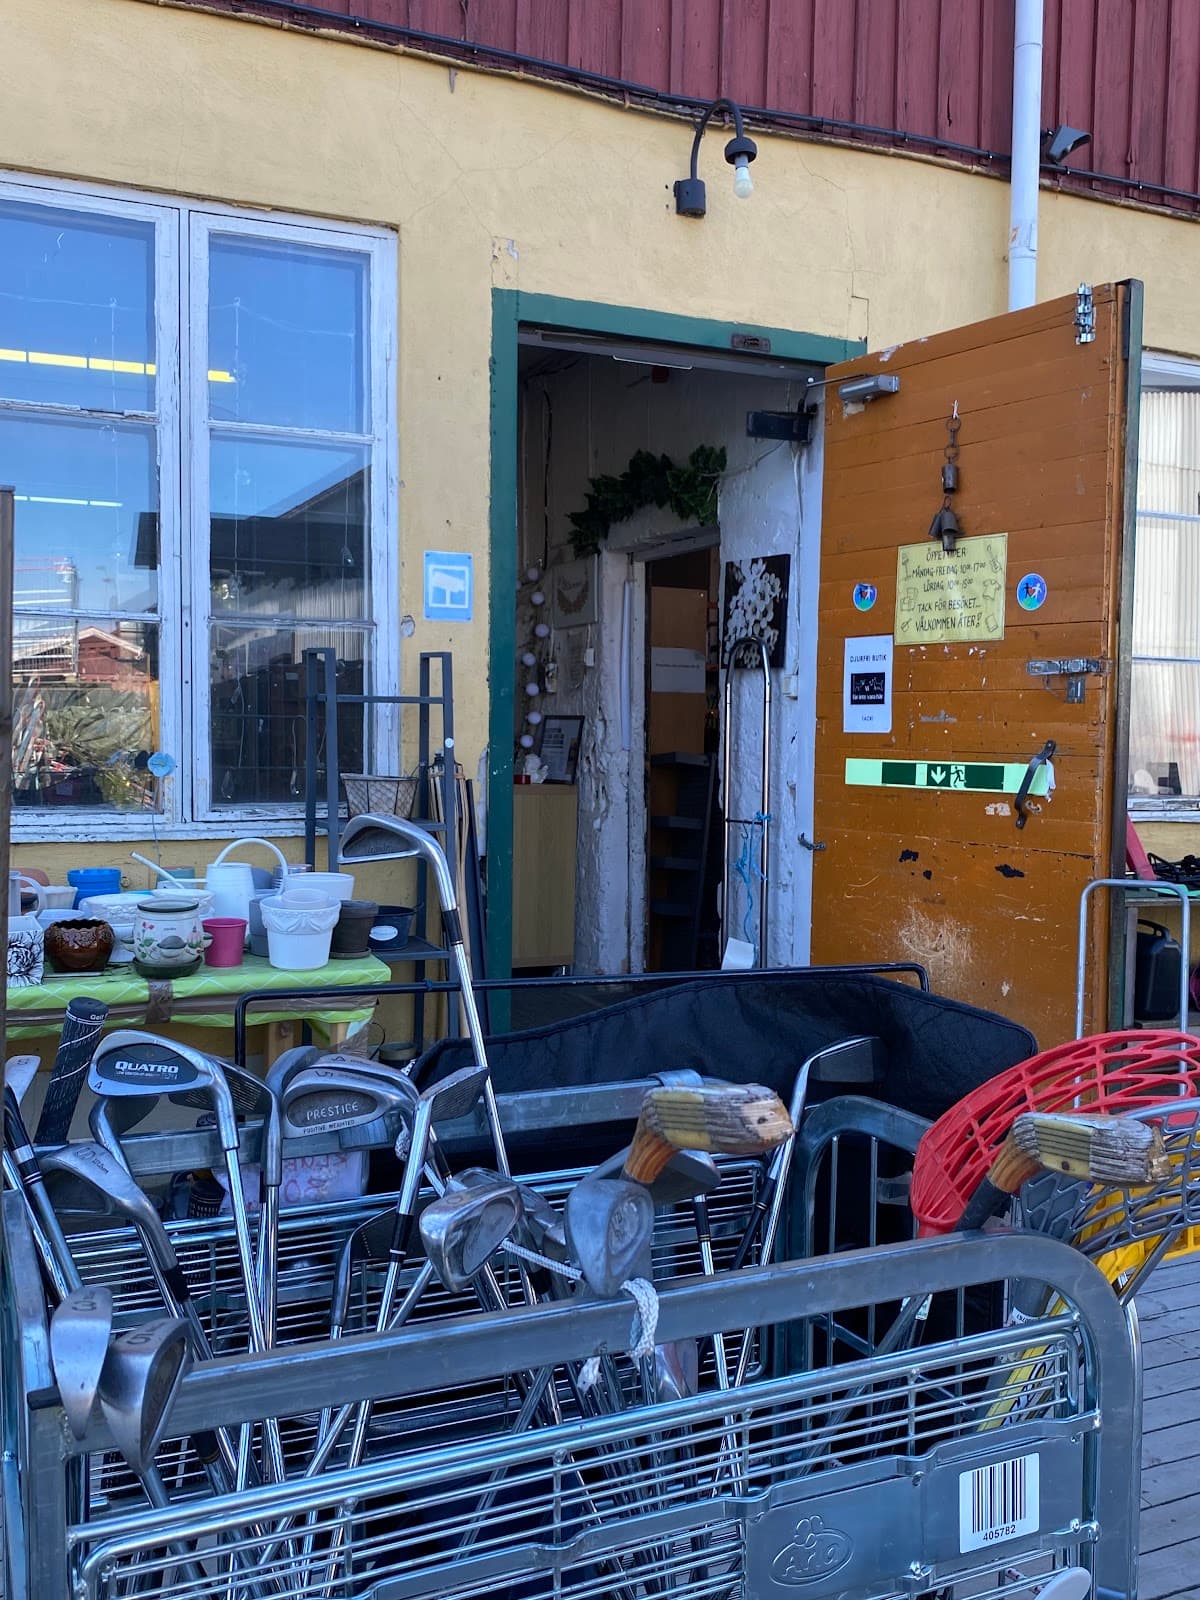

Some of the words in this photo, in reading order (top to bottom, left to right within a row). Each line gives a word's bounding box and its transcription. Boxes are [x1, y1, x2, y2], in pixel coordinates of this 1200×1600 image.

[917, 602, 932, 613] TACK
[934, 599, 947, 611] FÖR
[915, 616, 956, 632] VÄLKOMMEN
[114, 1061, 179, 1074] QUATRO
[306, 1101, 359, 1121] PRESTIGE
[983, 1524, 1017, 1541] 405782
